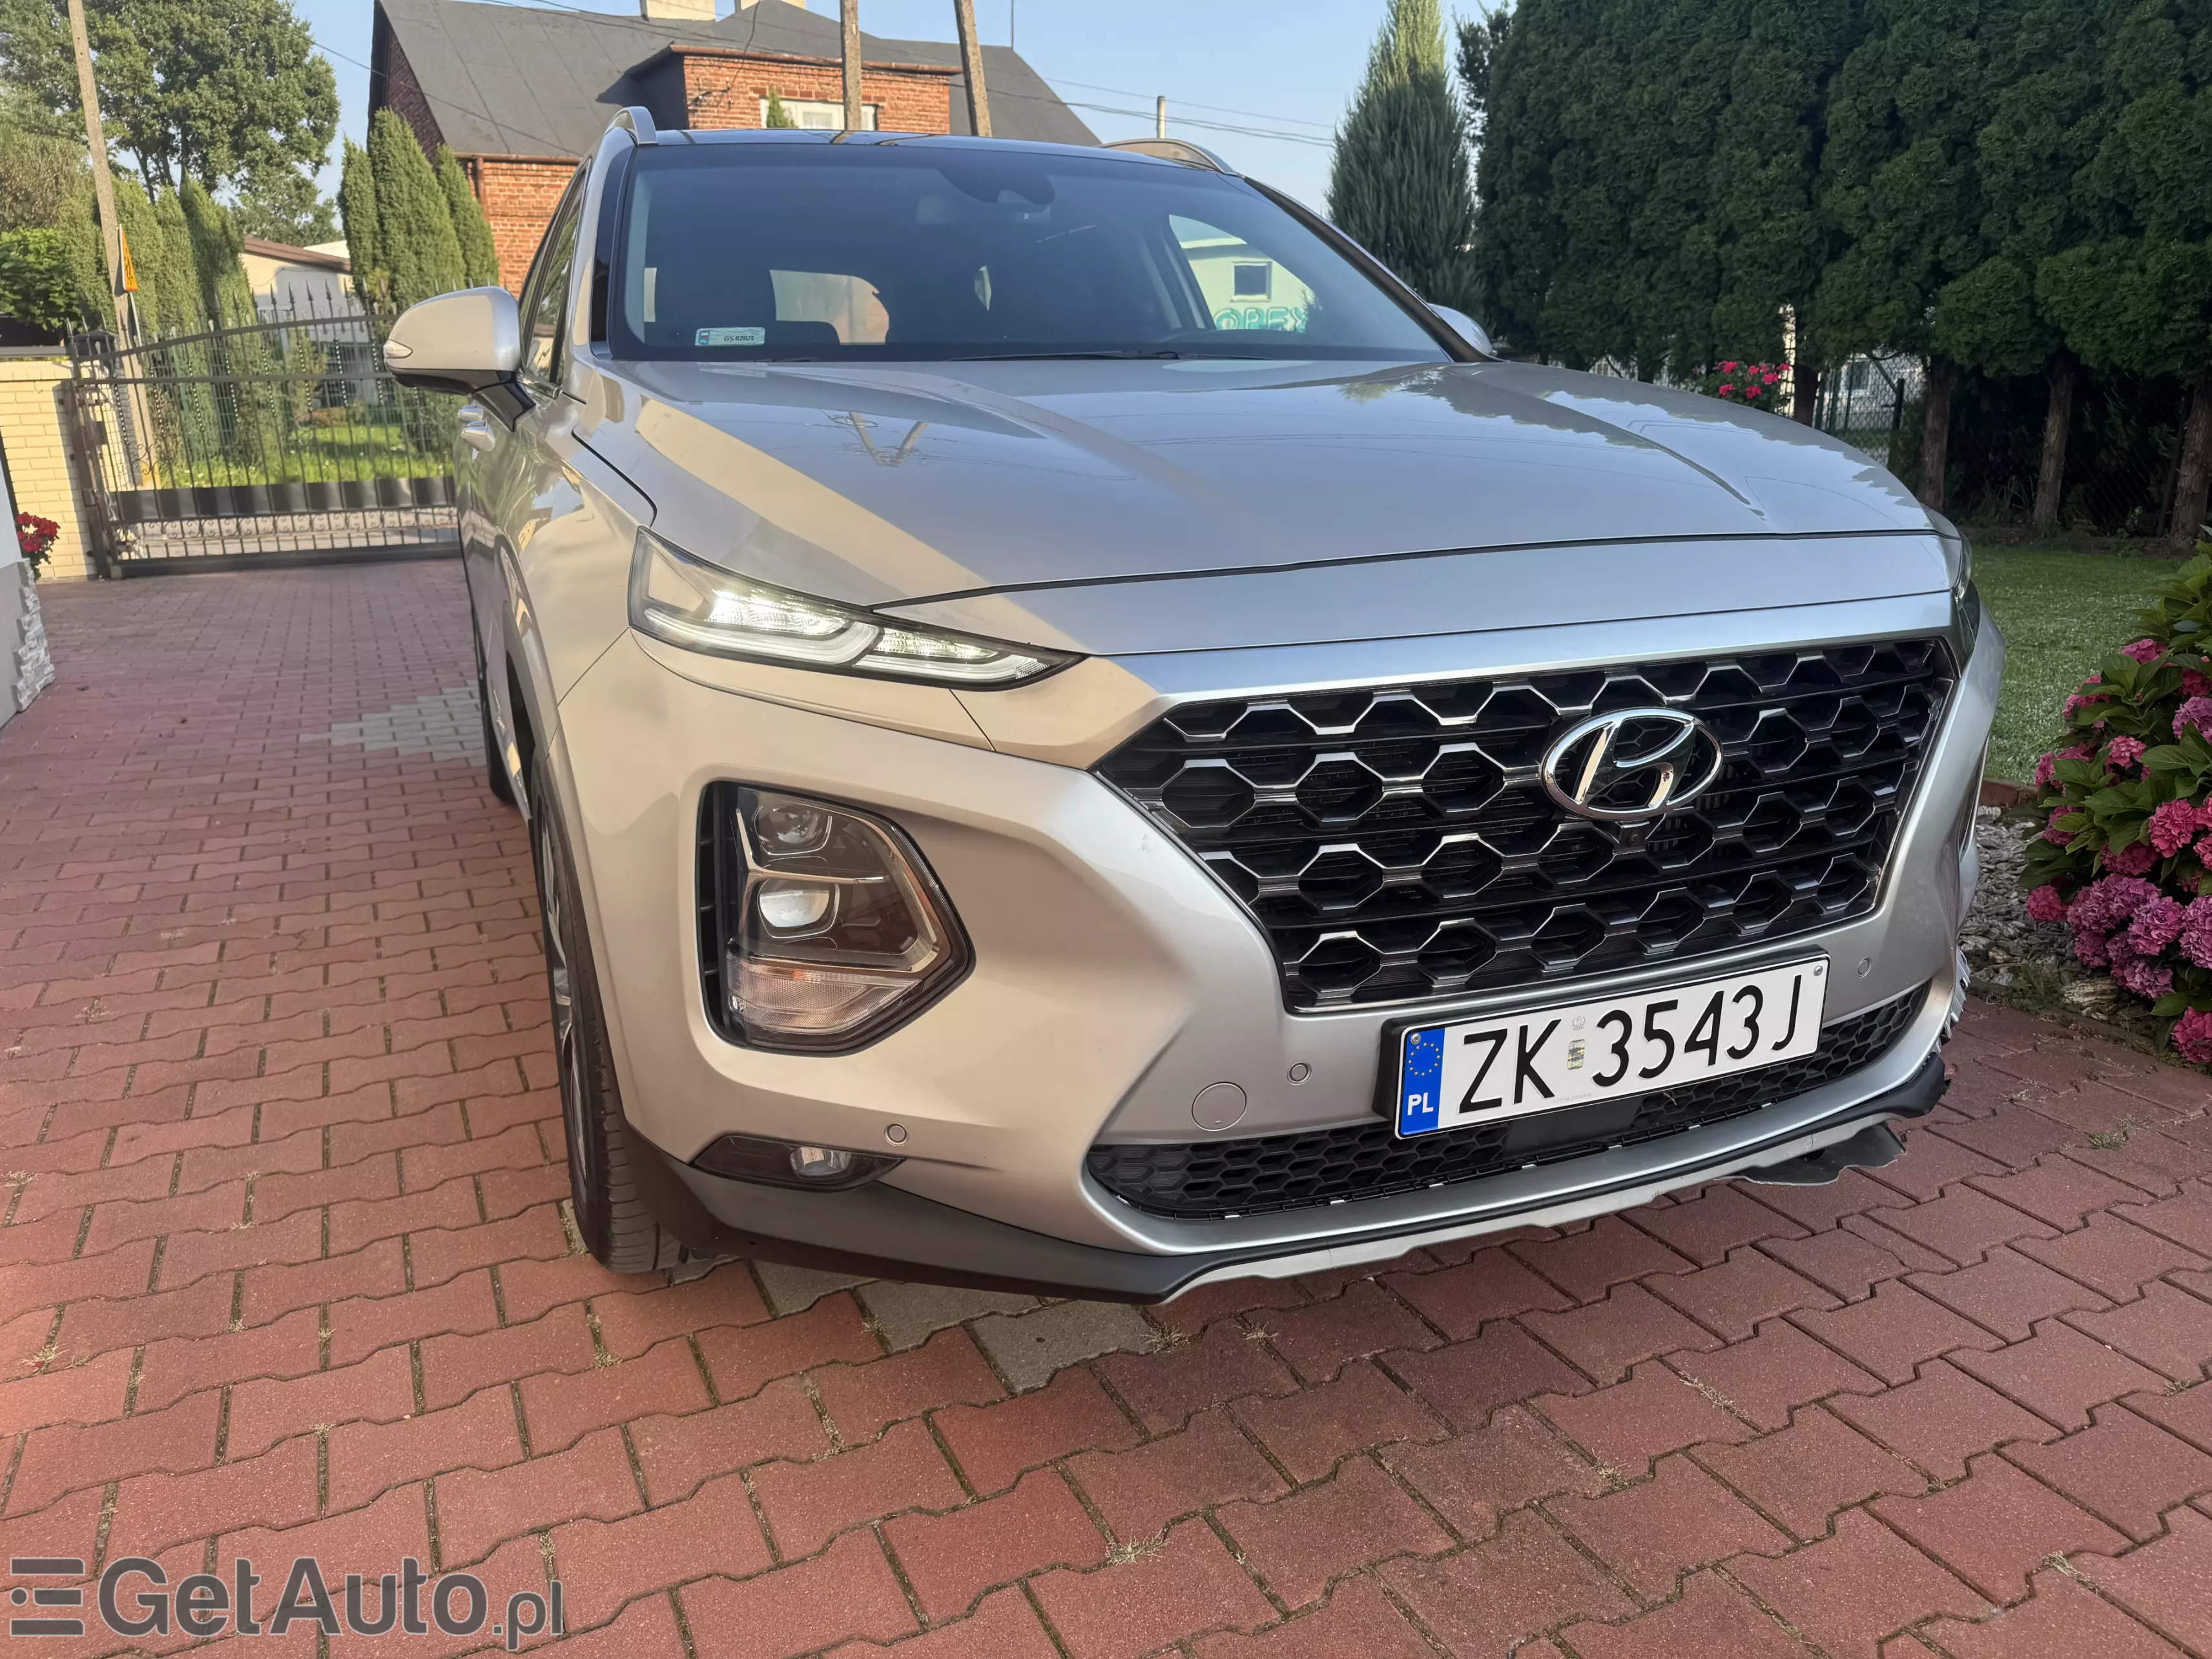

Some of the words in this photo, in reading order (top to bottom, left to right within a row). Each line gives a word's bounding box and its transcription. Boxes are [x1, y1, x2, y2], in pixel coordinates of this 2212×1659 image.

[1458, 1018, 1562, 1115] ZK
[1591, 974, 1803, 1087] 3543J
[1407, 1091, 1434, 1117] PL
